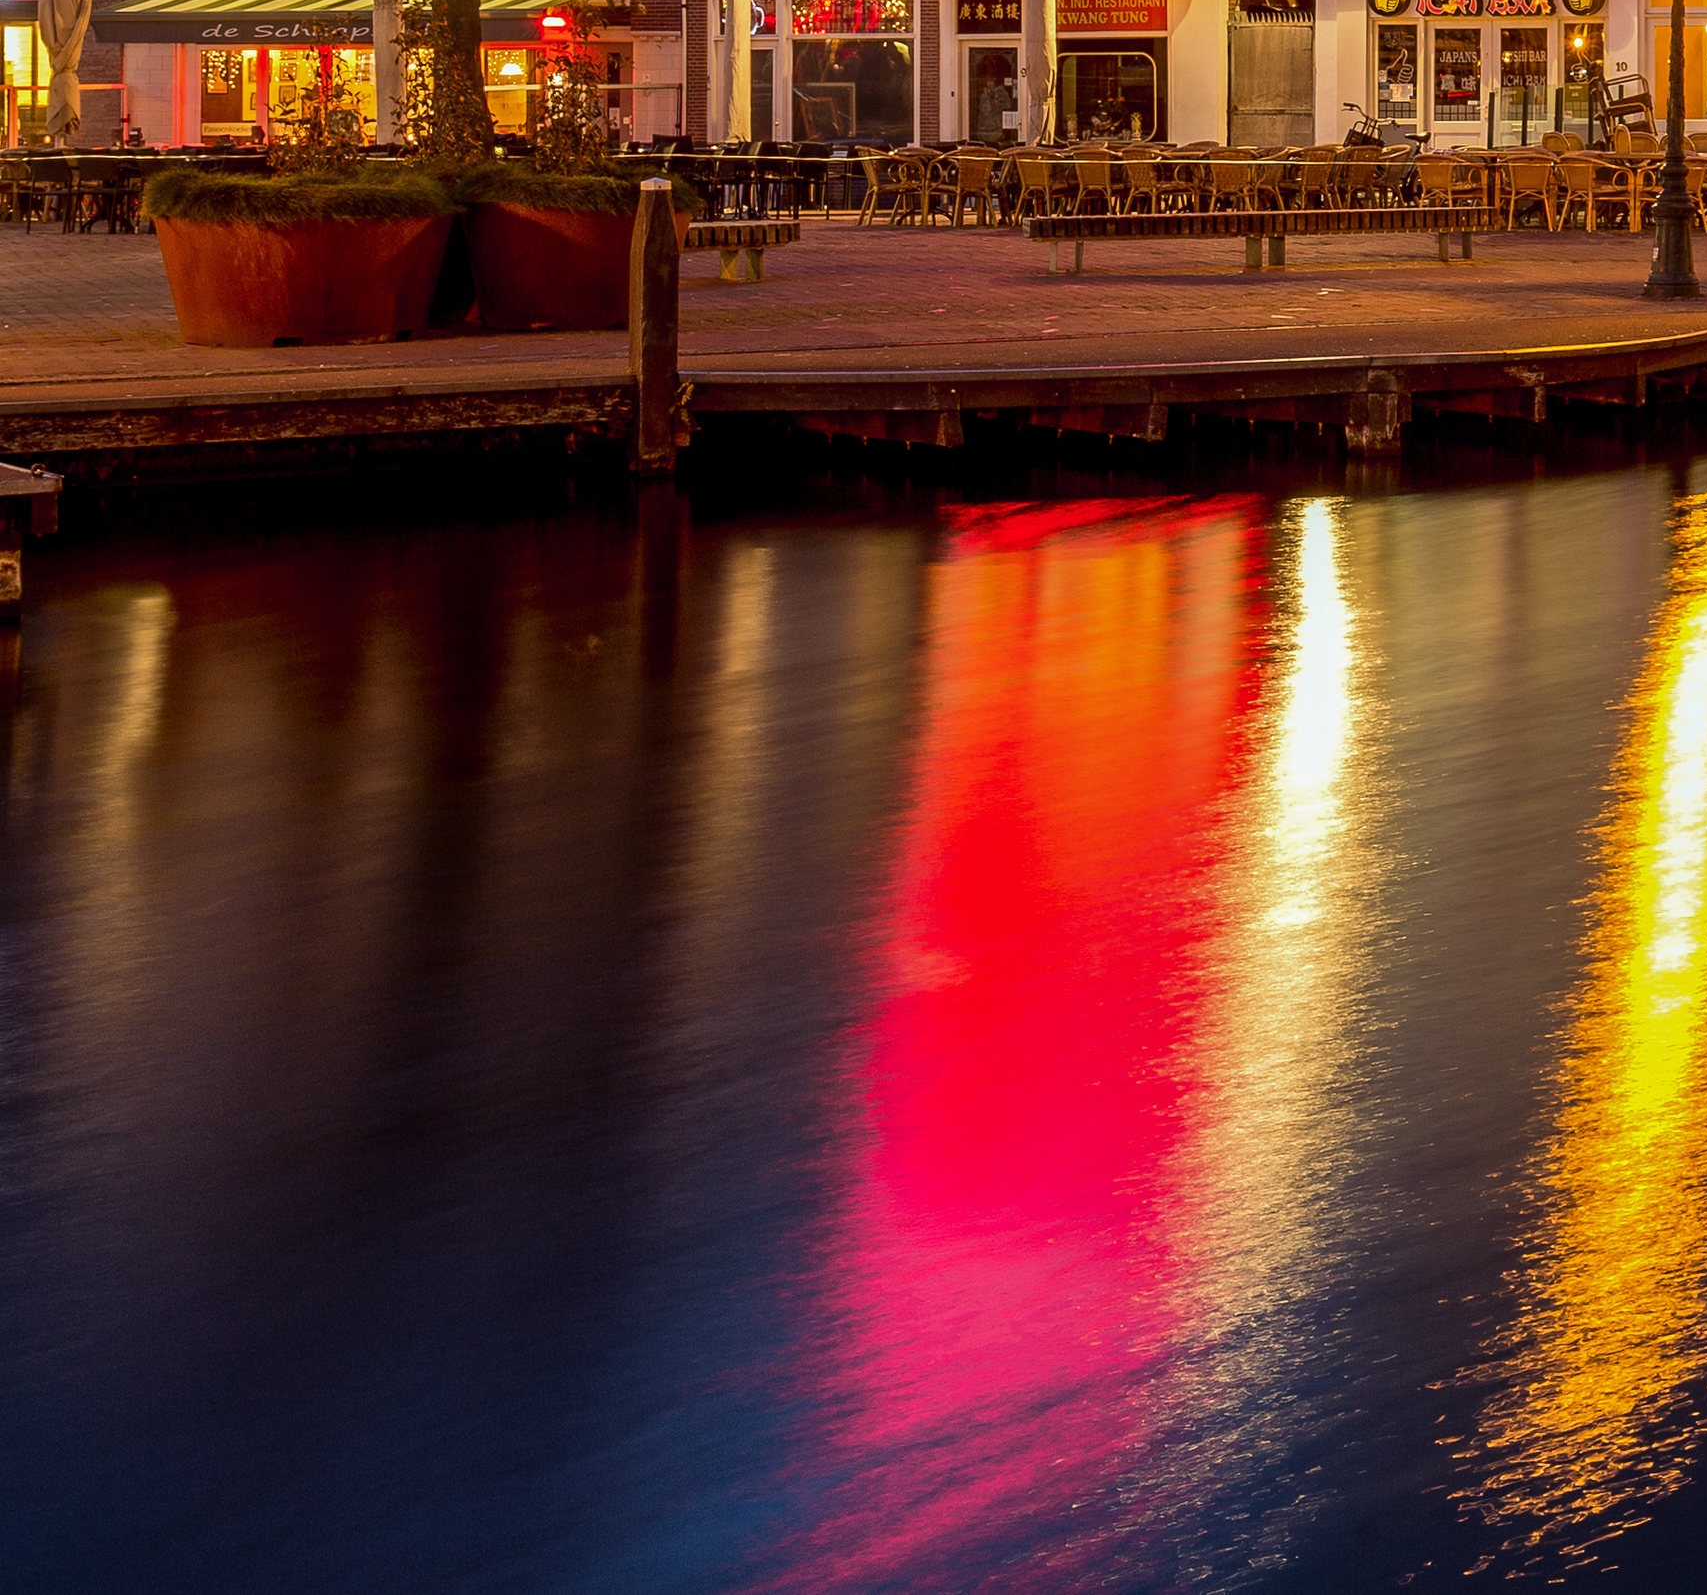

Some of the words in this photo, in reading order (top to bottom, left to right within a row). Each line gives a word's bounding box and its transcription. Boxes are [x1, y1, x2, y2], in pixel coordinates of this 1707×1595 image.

[1057, 11, 1109, 24] KWANG
[1111, 10, 1149, 23] TUNG
[202, 23, 240, 38] de
[1440, 51, 1478, 63] JAPANS
[1529, 50, 1547, 62] BAR
[1020, 67, 1027, 78] 9
[1616, 61, 1628, 72] 10
